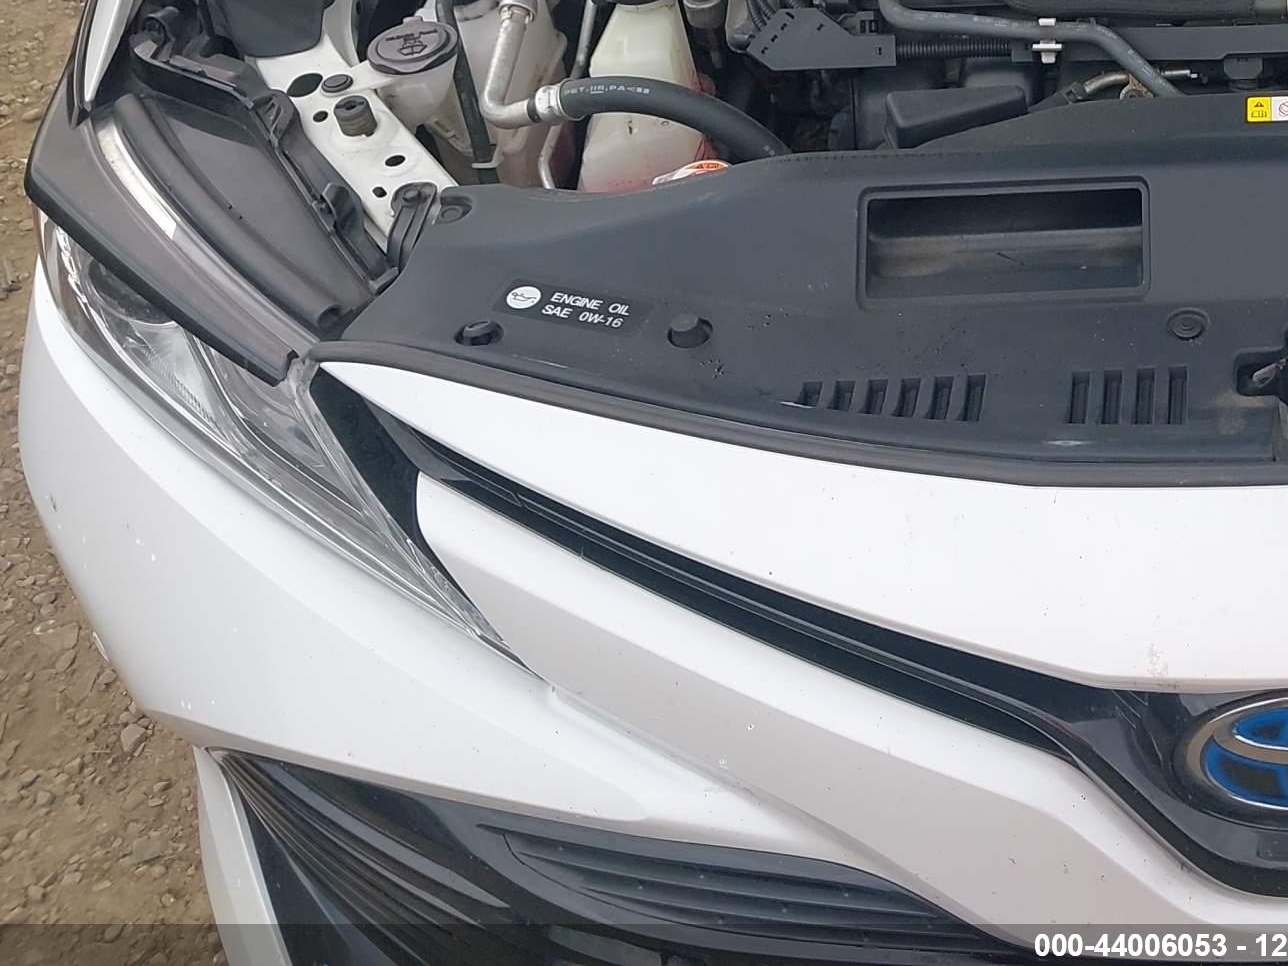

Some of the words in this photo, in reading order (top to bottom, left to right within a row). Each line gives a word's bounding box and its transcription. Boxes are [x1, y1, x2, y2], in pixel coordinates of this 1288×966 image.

[541, 304, 573, 319] SAE
[578, 312, 624, 328] 0W-16
[550, 292, 603, 310] ENGINE
[608, 303, 630, 316] OIL
